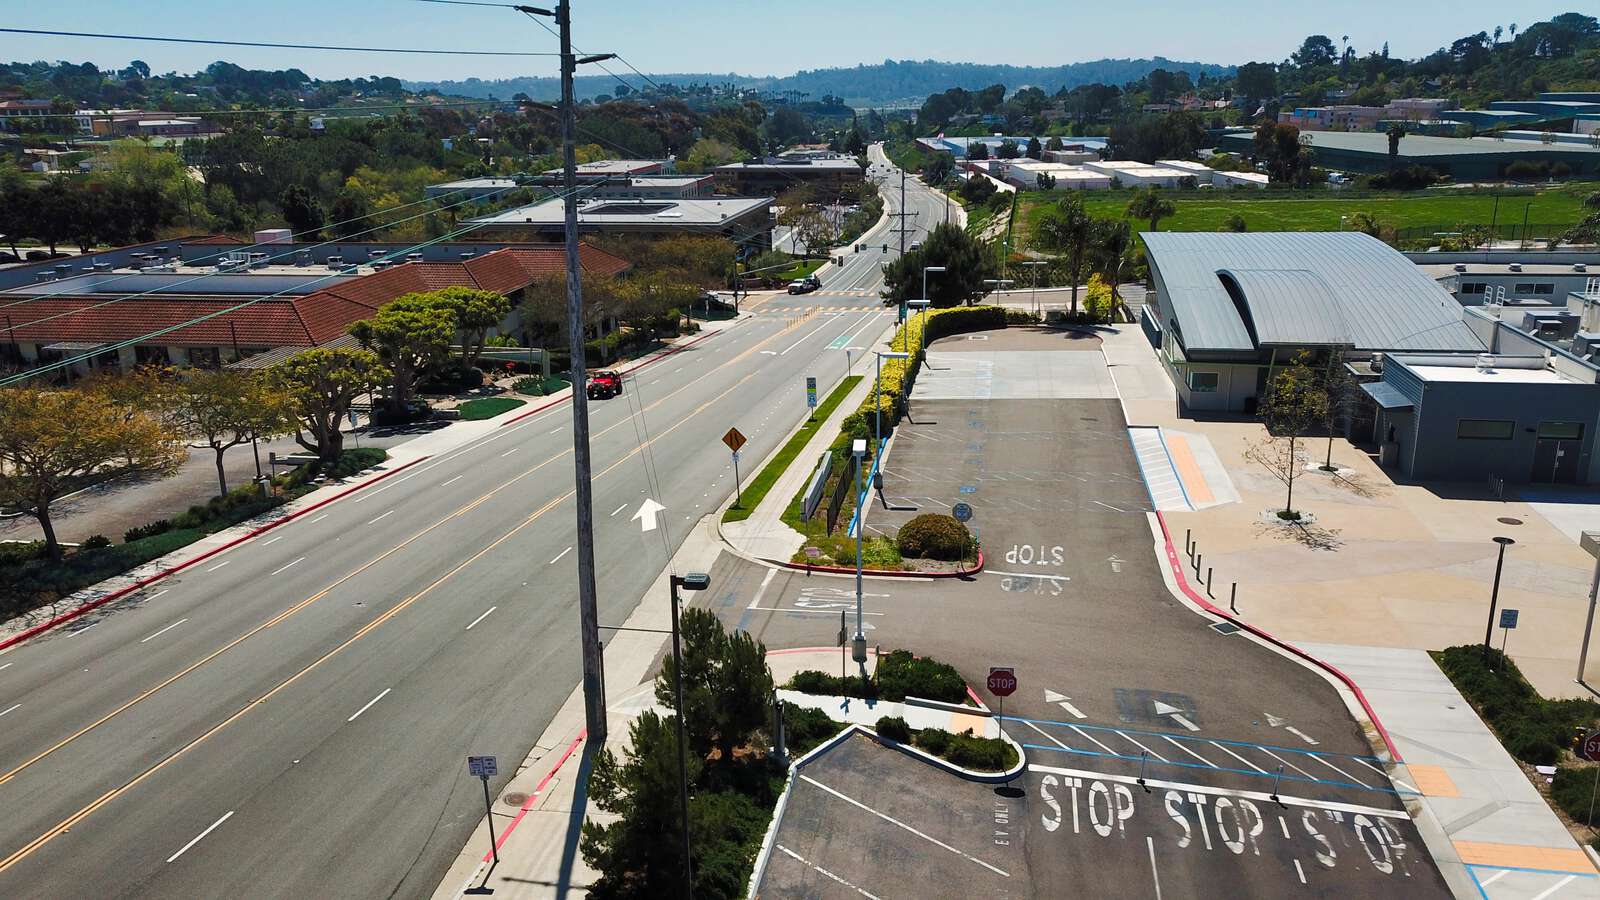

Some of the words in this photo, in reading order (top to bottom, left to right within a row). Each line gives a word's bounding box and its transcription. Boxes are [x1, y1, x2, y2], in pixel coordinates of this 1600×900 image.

[1005, 544, 1064, 566] STOP
[989, 678, 1015, 688] STOP
[994, 801, 1009, 824] ONLY
[1040, 774, 1135, 839] STOP
[1164, 790, 1264, 856] STOP
